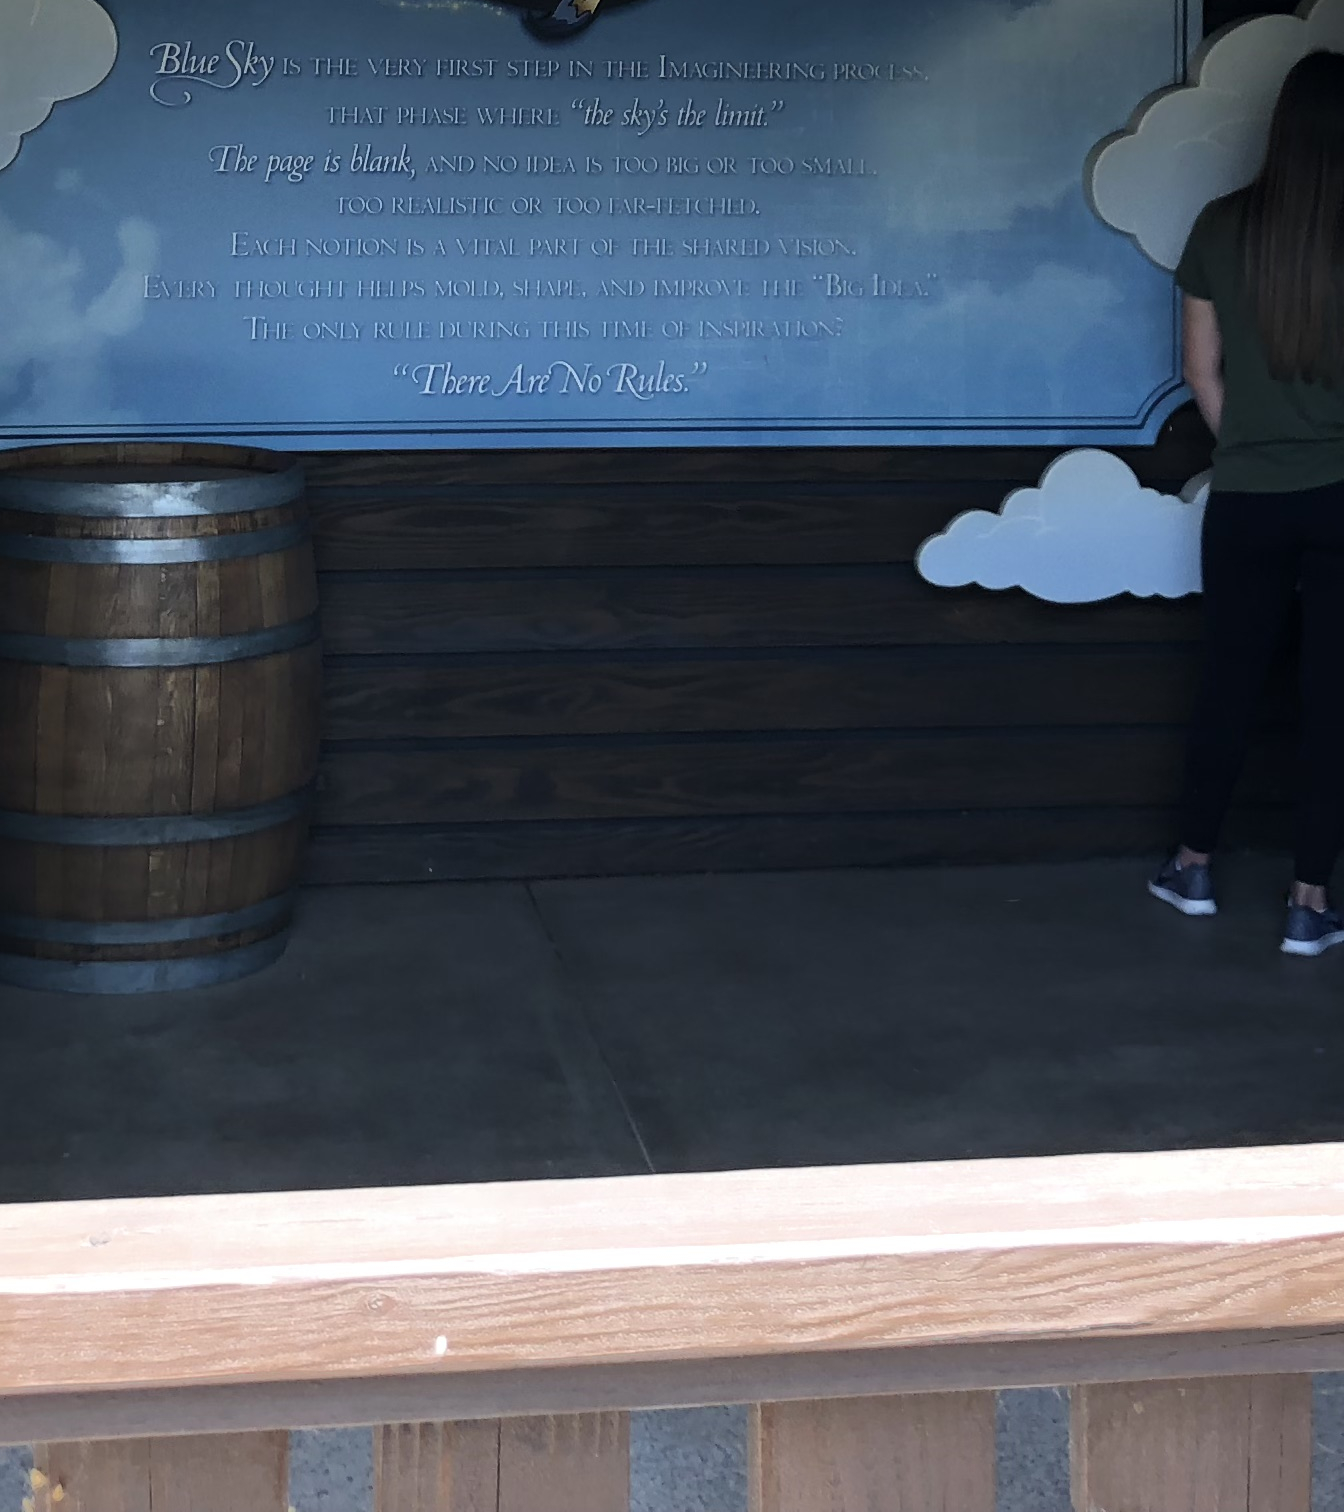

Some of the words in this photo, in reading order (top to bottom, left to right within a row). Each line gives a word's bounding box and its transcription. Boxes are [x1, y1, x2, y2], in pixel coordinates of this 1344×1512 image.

[149, 40, 220, 76] Blue
[282, 58, 301, 76] IS
[309, 57, 358, 76] THE
[367, 58, 428, 76] VERY
[436, 58, 499, 77] FIRST
[507, 59, 561, 78] STEP
[568, 60, 594, 78] IN
[602, 60, 648, 78] THE
[658, 54, 825, 80] IMAGINEERING
[325, 106, 389, 124] THAT
[397, 107, 467, 125] PHASE
[476, 107, 560, 125] WHERE
[676, 98, 706, 126] the
[208, 143, 258, 172] The
[264, 154, 314, 183] page
[323, 149, 341, 173] is
[350, 143, 417, 180] blank,
[424, 155, 475, 173] AND
[483, 155, 518, 173] NO
[526, 156, 576, 173] IDEA
[585, 156, 603, 174] IS
[612, 156, 659, 174] TOO
[666, 156, 699, 174] BIG
[707, 156, 738, 174] OR
[747, 157, 794, 174] TOO
[801, 157, 879, 175] SMALL.
[337, 196, 383, 214] TOO
[391, 196, 504, 214] REALISTIC
[511, 196, 543, 214] OR
[552, 196, 601, 214] TOO
[608, 197, 761, 215] FAR-FETCHED.
[230, 231, 296, 256] EACH
[306, 238, 397, 256] NOTION
[407, 238, 425, 256] IS
[432, 238, 446, 256] A
[455, 238, 520, 256] VITAL
[529, 238, 584, 256] PART
[590, 238, 620, 256] OF
[630, 238, 674, 256] THE
[682, 238, 770, 256] SHARED
[778, 238, 857, 256] VISION.
[143, 274, 218, 299] EVERY
[234, 279, 346, 297] THOUGHT
[357, 279, 425, 297] HELPS
[434, 279, 504, 299] MOLD,
[512, 279, 587, 299] SHAPE,
[596, 279, 645, 297] AND
[654, 279, 751, 297] IMPROVE
[762, 279, 803, 297] THE
[242, 316, 295, 340] THE
[303, 321, 362, 340] ONLY
[373, 321, 431, 339] RULE
[439, 321, 530, 339] DURING
[540, 321, 590, 338] THIS
[601, 320, 654, 338] TIME
[662, 320, 691, 338] OF
[491, 363, 550, 397] Are
[548, 360, 602, 393] No
